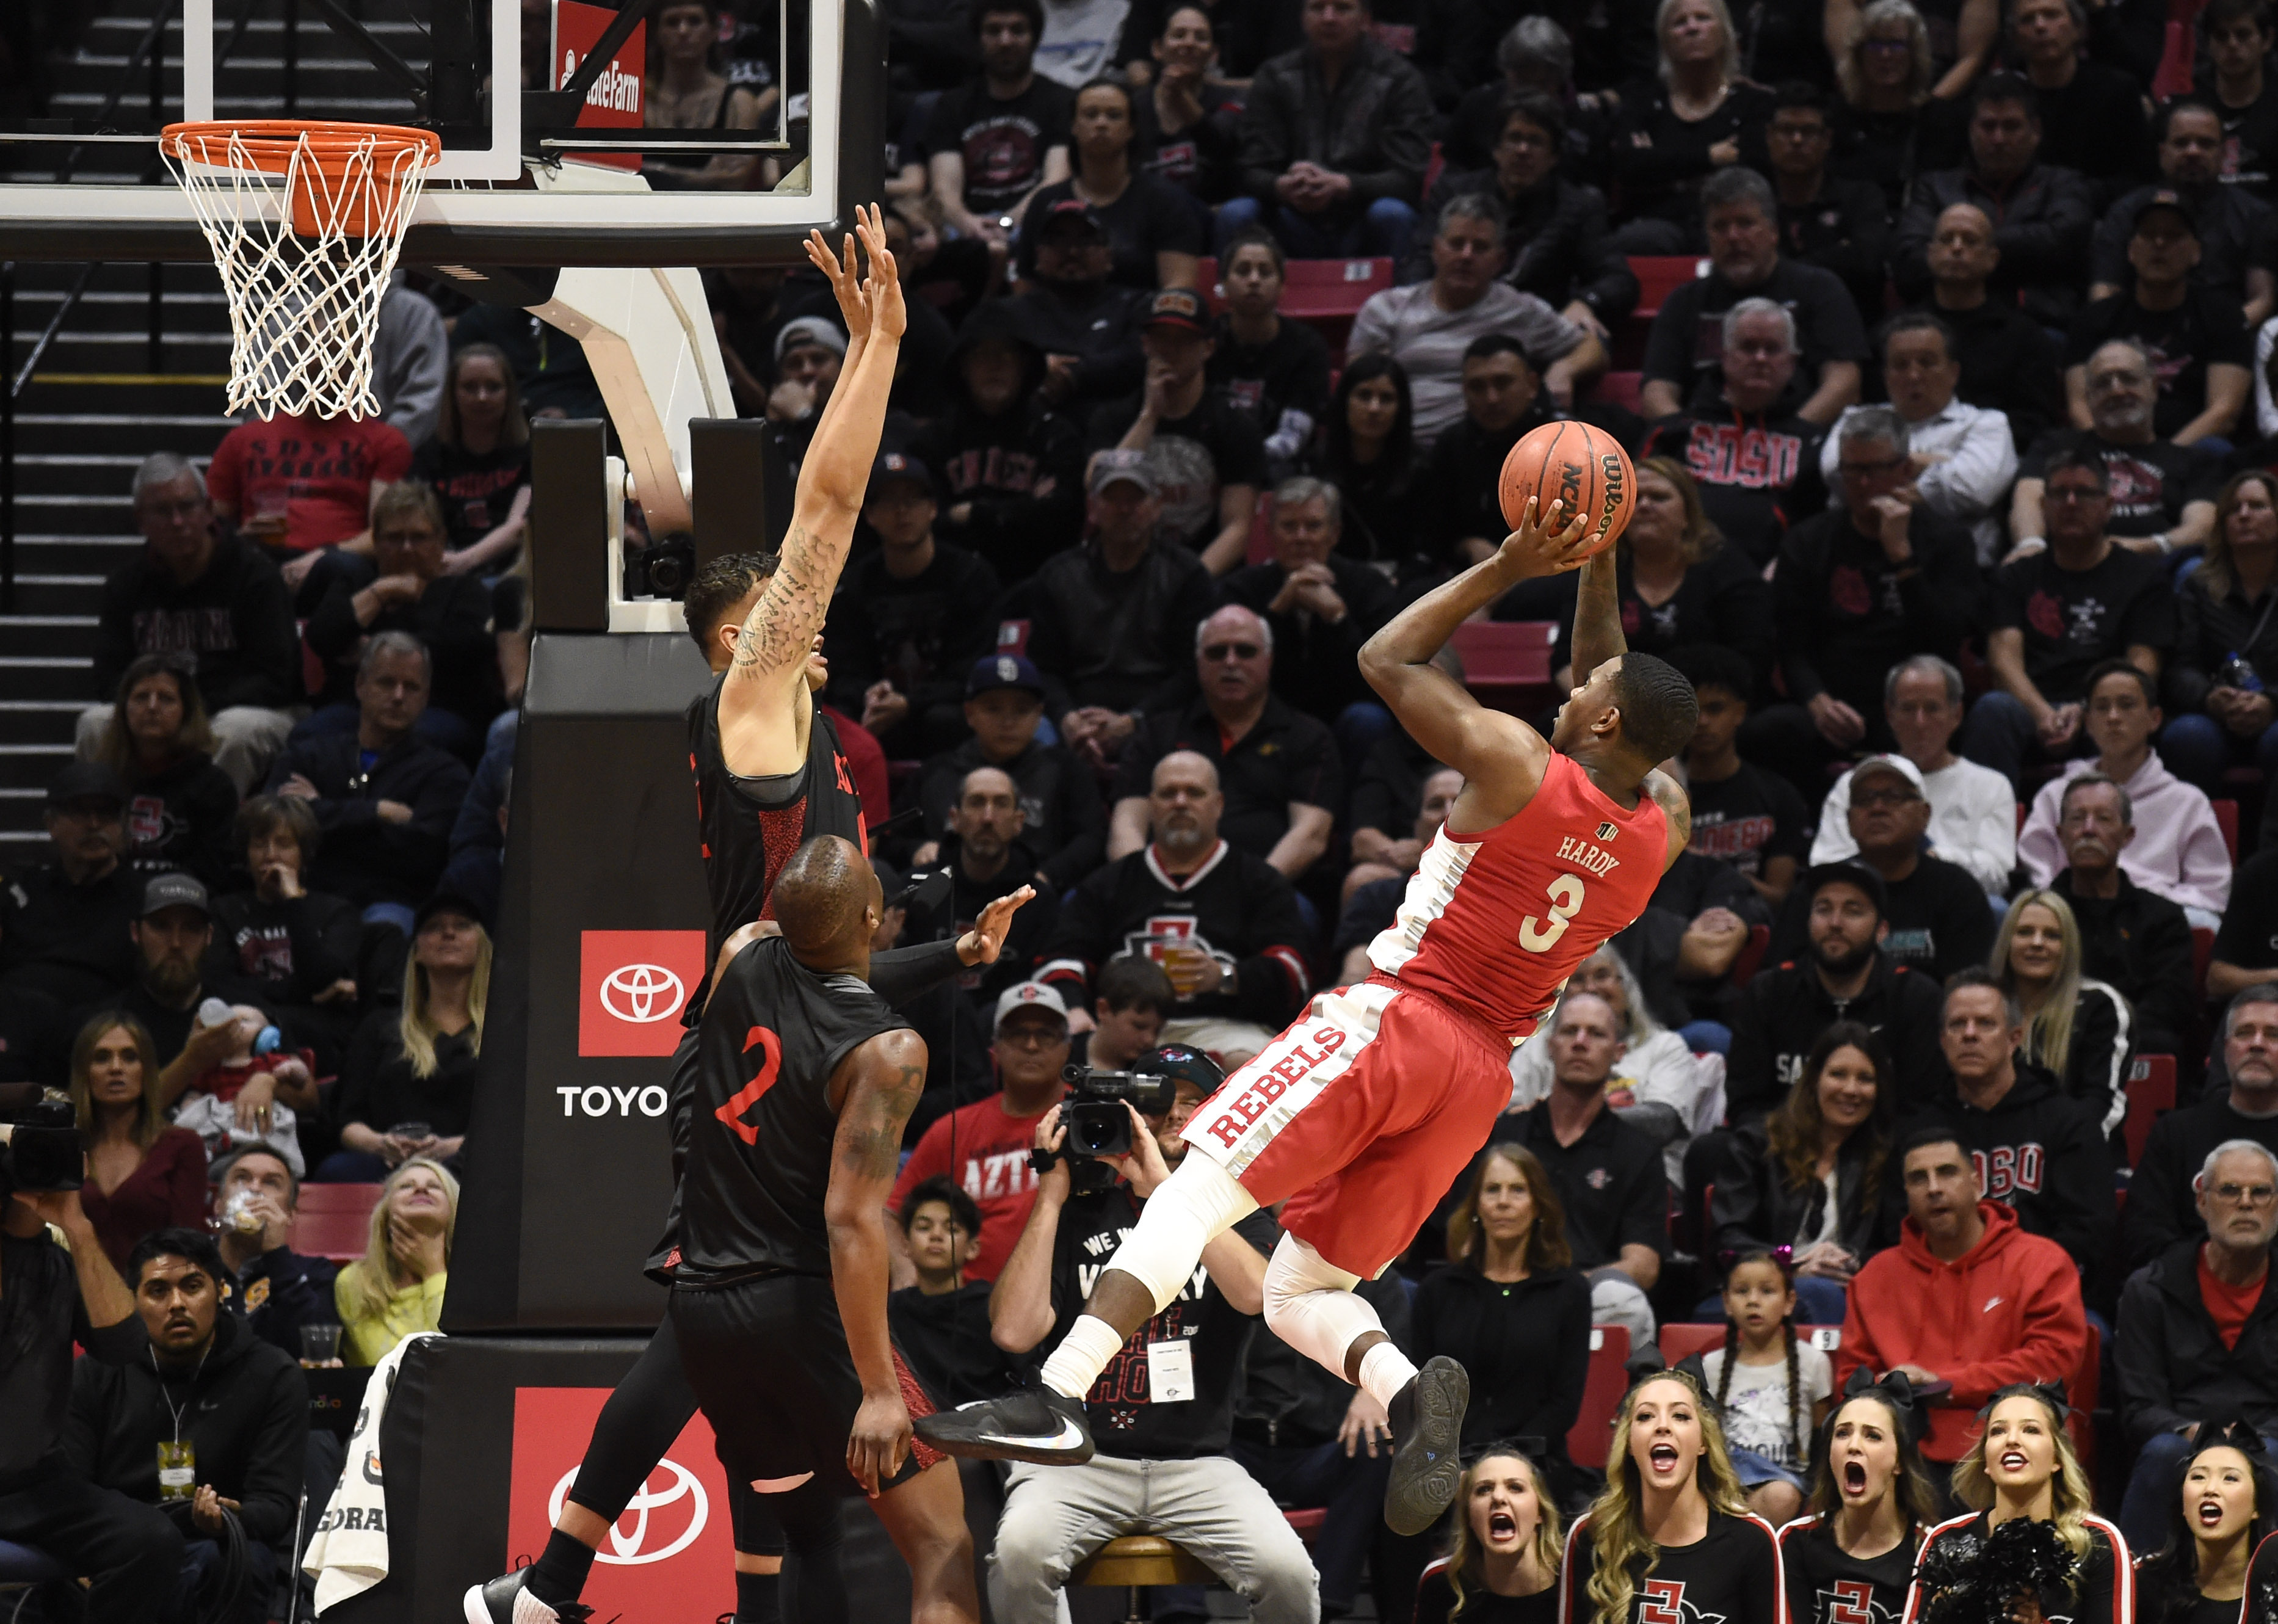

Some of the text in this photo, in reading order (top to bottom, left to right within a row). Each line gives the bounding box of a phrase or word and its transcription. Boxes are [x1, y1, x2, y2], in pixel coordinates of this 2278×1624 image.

[1555, 836, 1620, 878] HARDY
[1518, 873, 1585, 953] 3
[715, 1026, 782, 1145] 2
[1206, 1026, 1346, 1149] REBELS
[1083, 1231, 1115, 1257] WE
